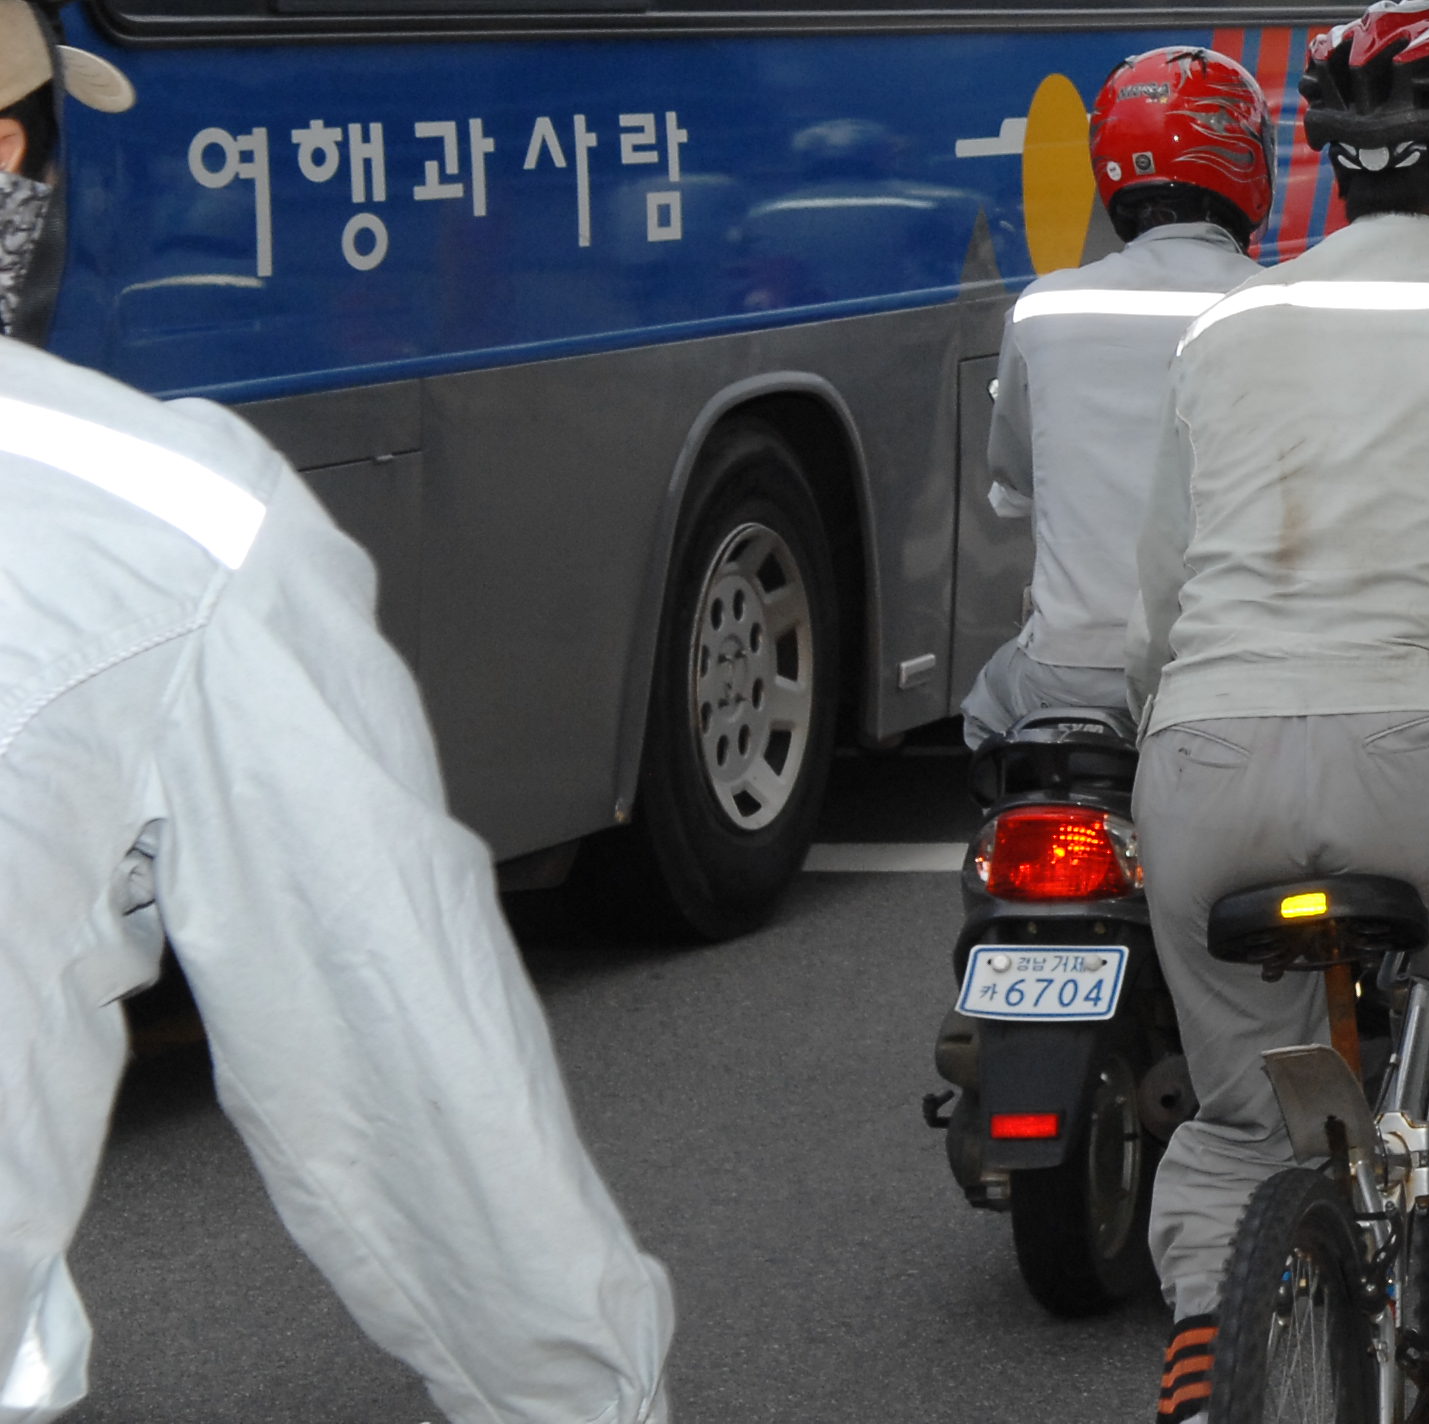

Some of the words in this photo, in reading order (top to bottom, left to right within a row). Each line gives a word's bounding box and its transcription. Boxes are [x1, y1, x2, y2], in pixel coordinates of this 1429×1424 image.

[1016, 956, 1047, 972] 경남
[1050, 955, 1086, 973] 거제
[1004, 978, 1104, 1008] 6704
